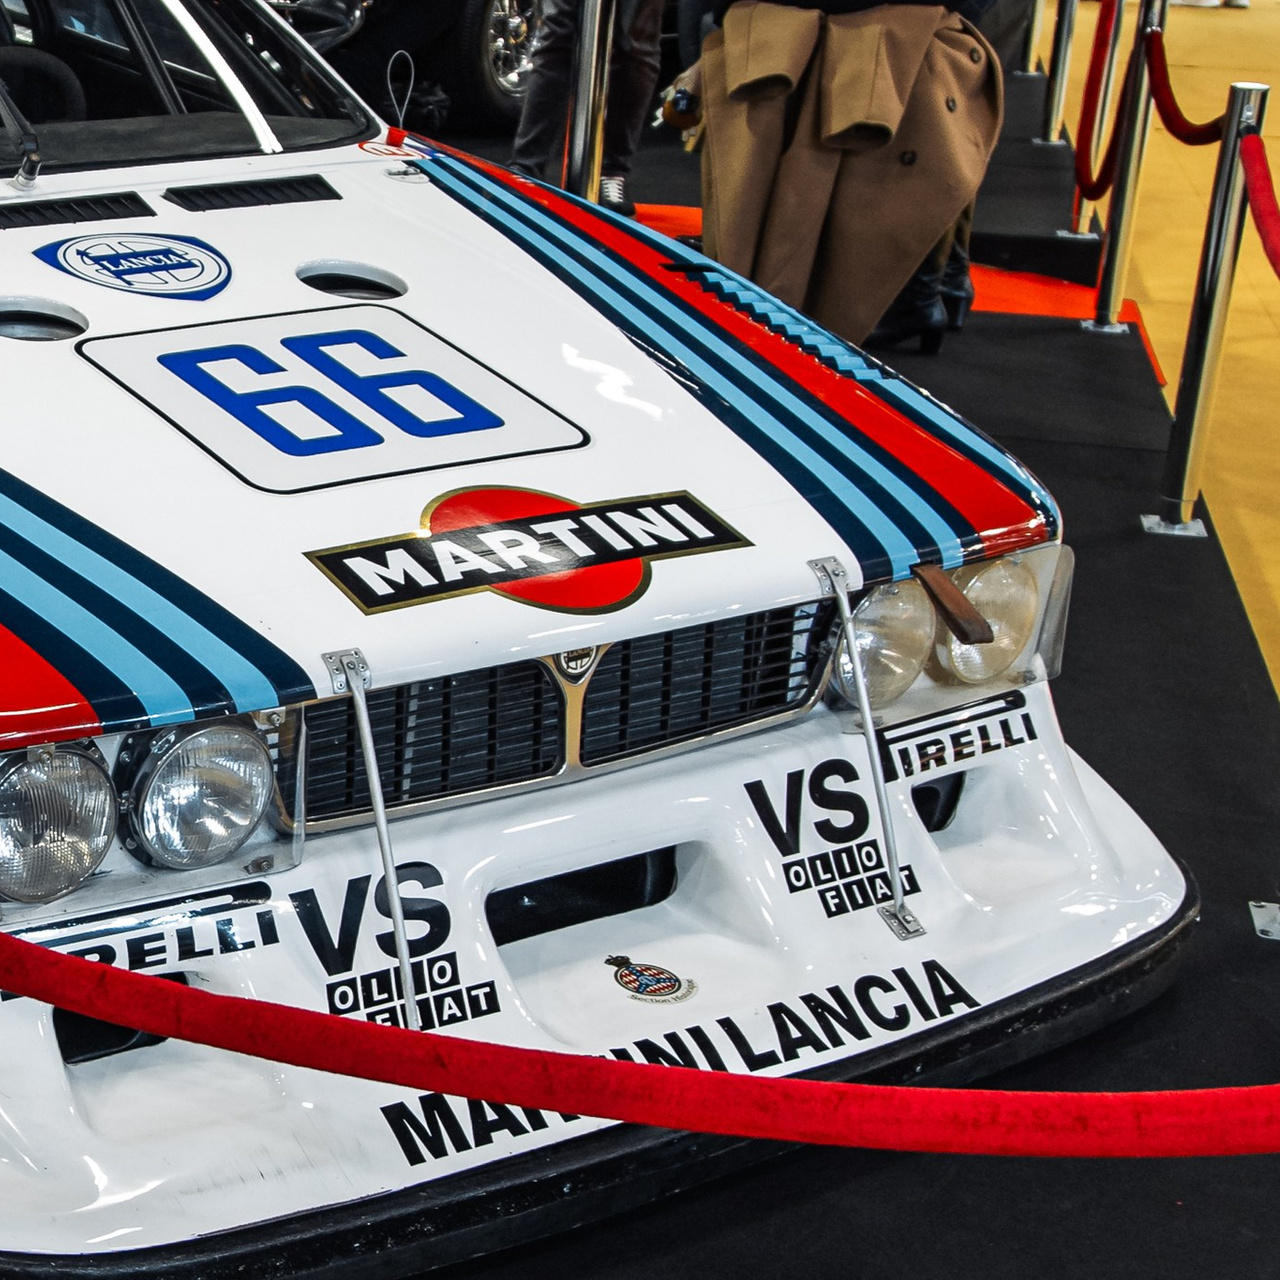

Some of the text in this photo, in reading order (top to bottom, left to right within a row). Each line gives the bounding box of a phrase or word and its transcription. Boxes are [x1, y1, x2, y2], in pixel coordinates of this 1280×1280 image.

[100, 253, 189, 271] LANCIA
[156, 328, 506, 458] 66
[341, 502, 718, 597] MARTINI
[875, 689, 1038, 784] PIRELLI
[743, 757, 871, 857] VS
[787, 844, 880, 892] OLIO
[823, 871, 915, 914] FIAT
[288, 861, 452, 977] VS
[333, 960, 453, 1010] OLO
[715, 959, 981, 1073] LANCIA
